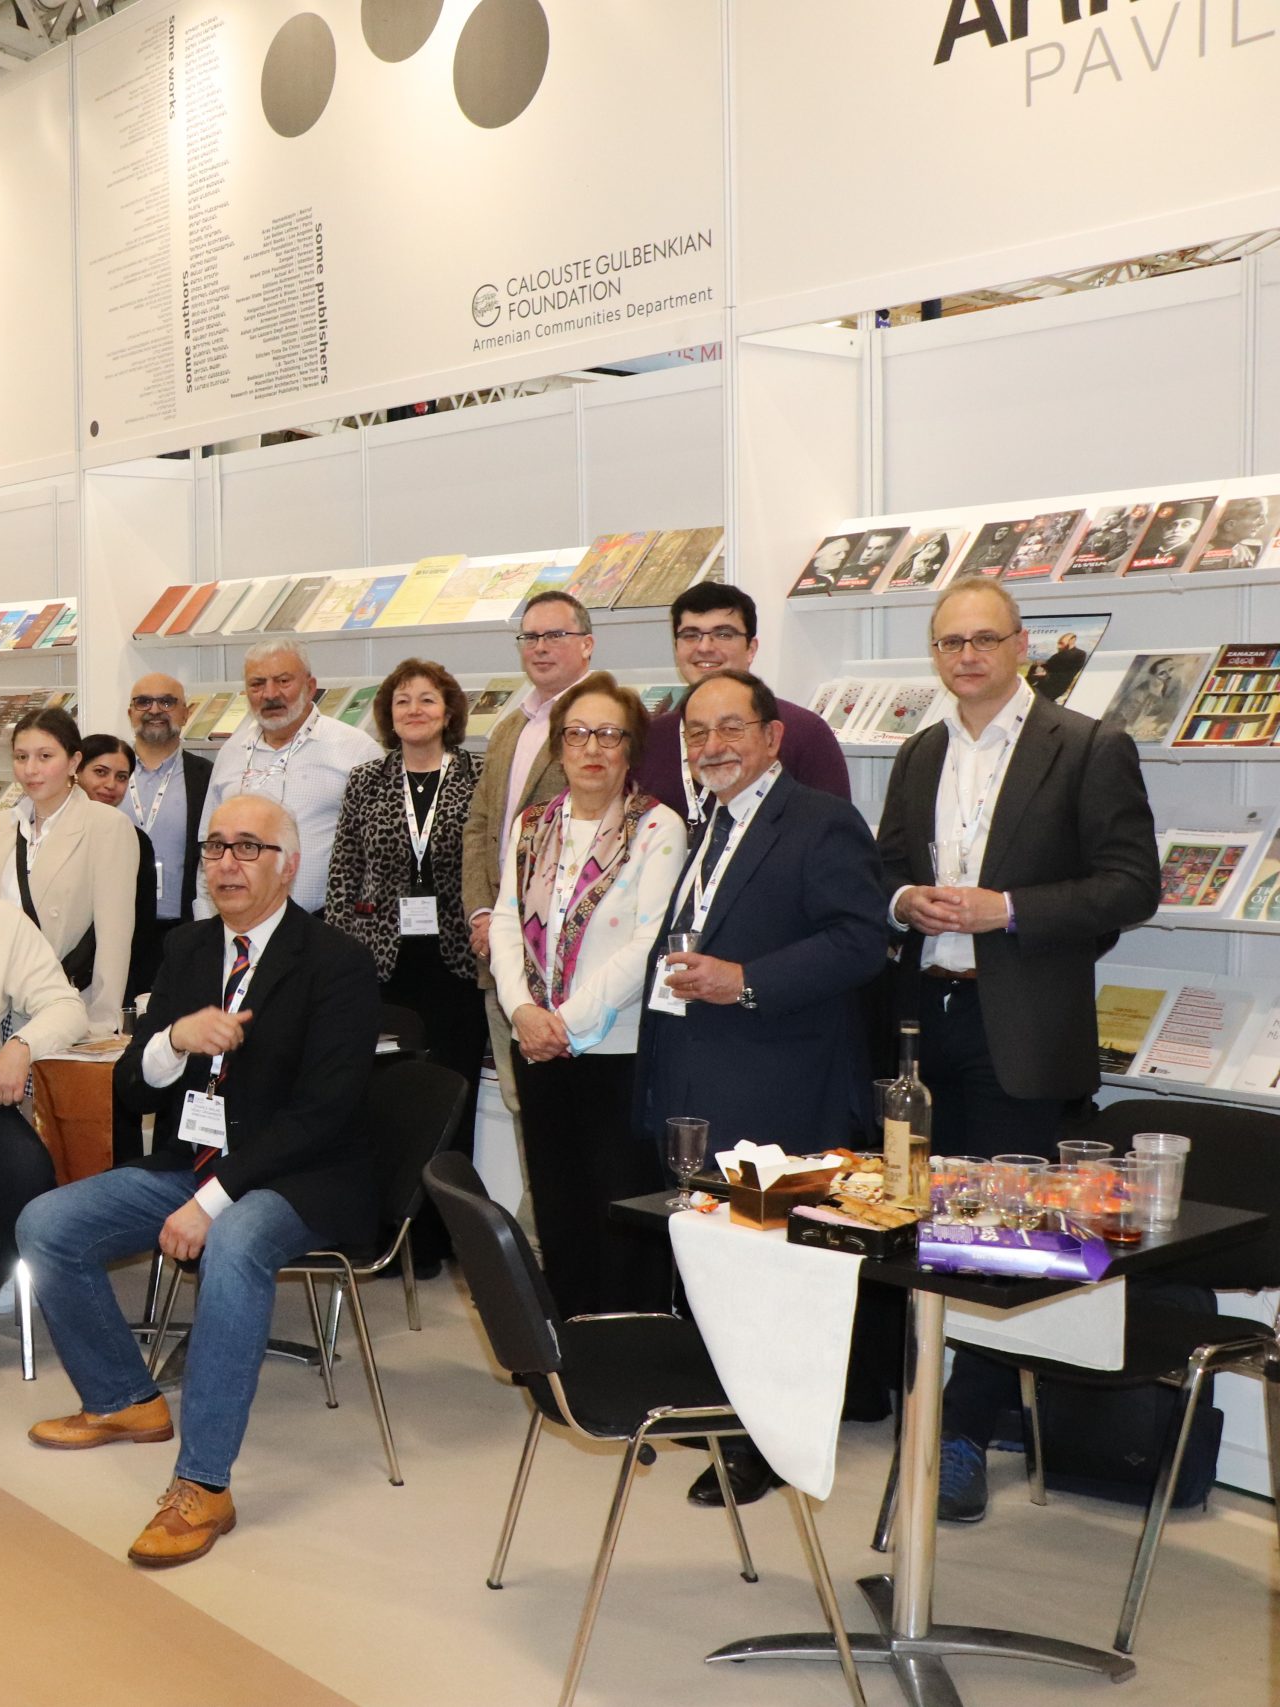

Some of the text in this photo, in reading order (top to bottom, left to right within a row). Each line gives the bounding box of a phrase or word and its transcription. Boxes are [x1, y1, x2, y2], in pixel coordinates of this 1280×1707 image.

[168, 14, 177, 120] some works
[315, 222, 328, 385] some publishers
[506, 229, 713, 297] CALOUSTE GULBENKIAN
[508, 276, 622, 321] FOUNDATION
[181, 269, 193, 394] some authors
[472, 286, 714, 352] Armenian Communities Department
